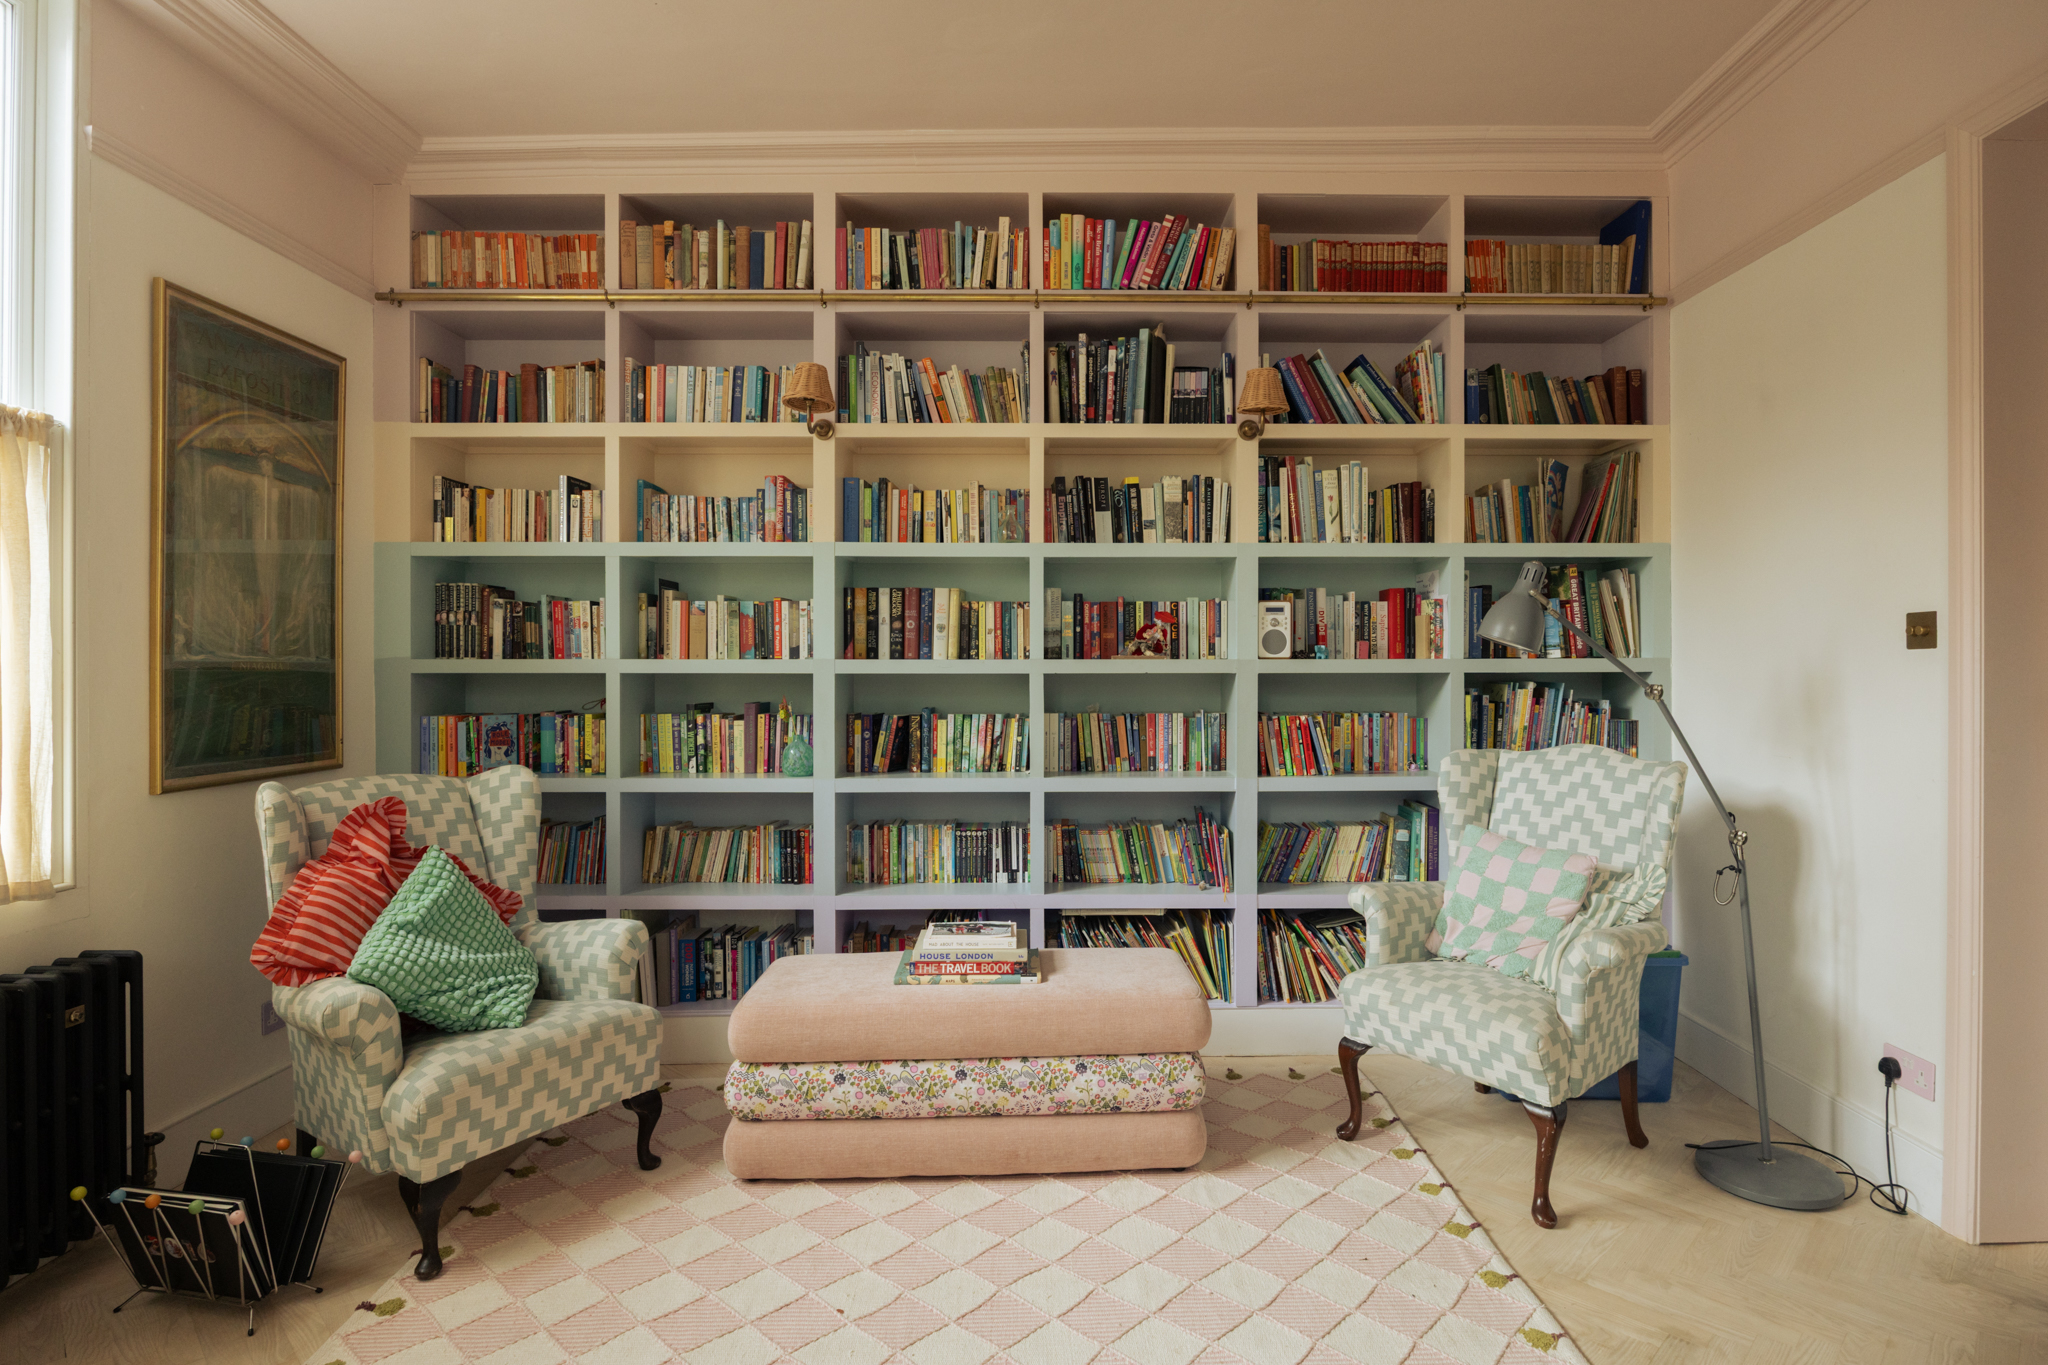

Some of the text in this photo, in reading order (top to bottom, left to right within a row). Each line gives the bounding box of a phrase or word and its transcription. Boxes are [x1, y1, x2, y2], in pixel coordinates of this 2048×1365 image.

[1096, 225, 1102, 234] Me
[1149, 224, 1158, 239] Greta
[1167, 219, 1179, 243] AMERICA
[1173, 226, 1181, 238] SOUL
[1131, 226, 1146, 260] Malorie Blackman
[1142, 242, 1152, 259] Valdin
[1180, 244, 1189, 262] ROONEY
[1058, 496, 1066, 531] Empire
[1570, 578, 1578, 601] GREAT
[1572, 602, 1581, 629] BRITAIN
[239, 662, 284, 670] NIAGARA
[917, 963, 1012, 973] THE TRAVEL BOOK
